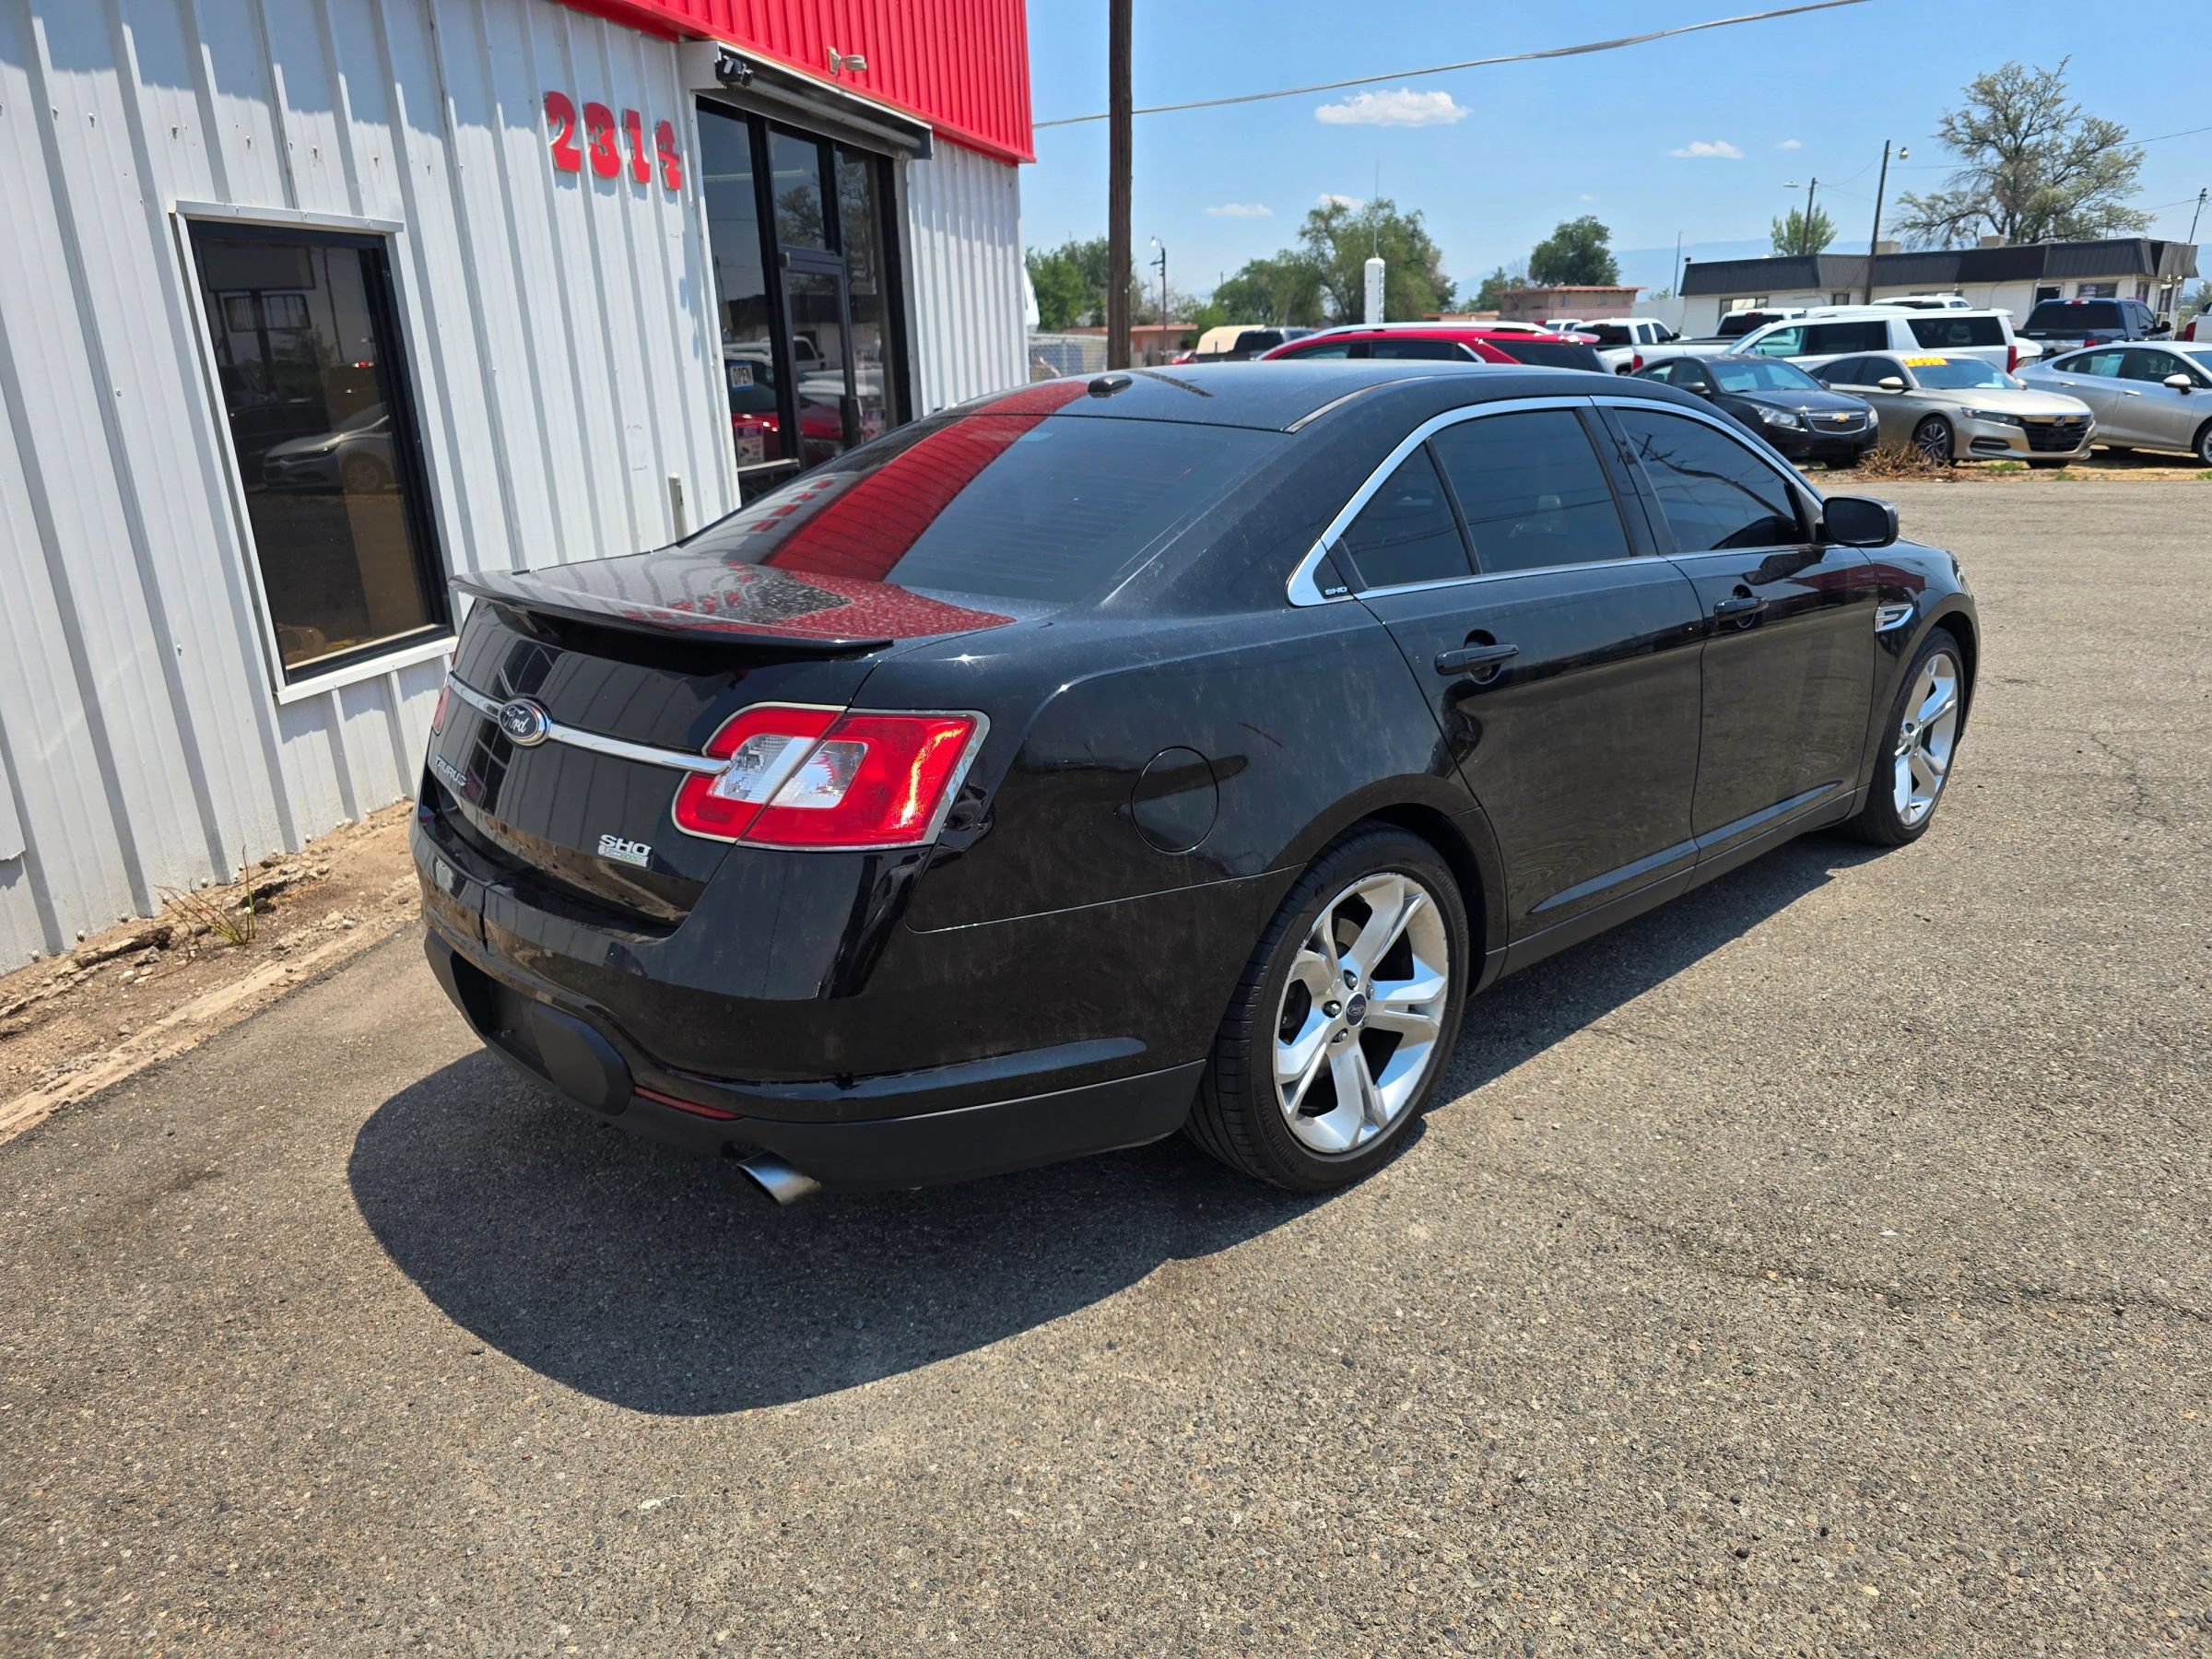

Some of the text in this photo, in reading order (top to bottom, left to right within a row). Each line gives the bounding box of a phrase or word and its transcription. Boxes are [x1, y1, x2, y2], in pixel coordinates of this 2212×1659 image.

[544, 90, 682, 192] 2314
[733, 367, 751, 385] OPEN
[435, 753, 467, 787] TAURUS
[598, 834, 653, 857] SHO
